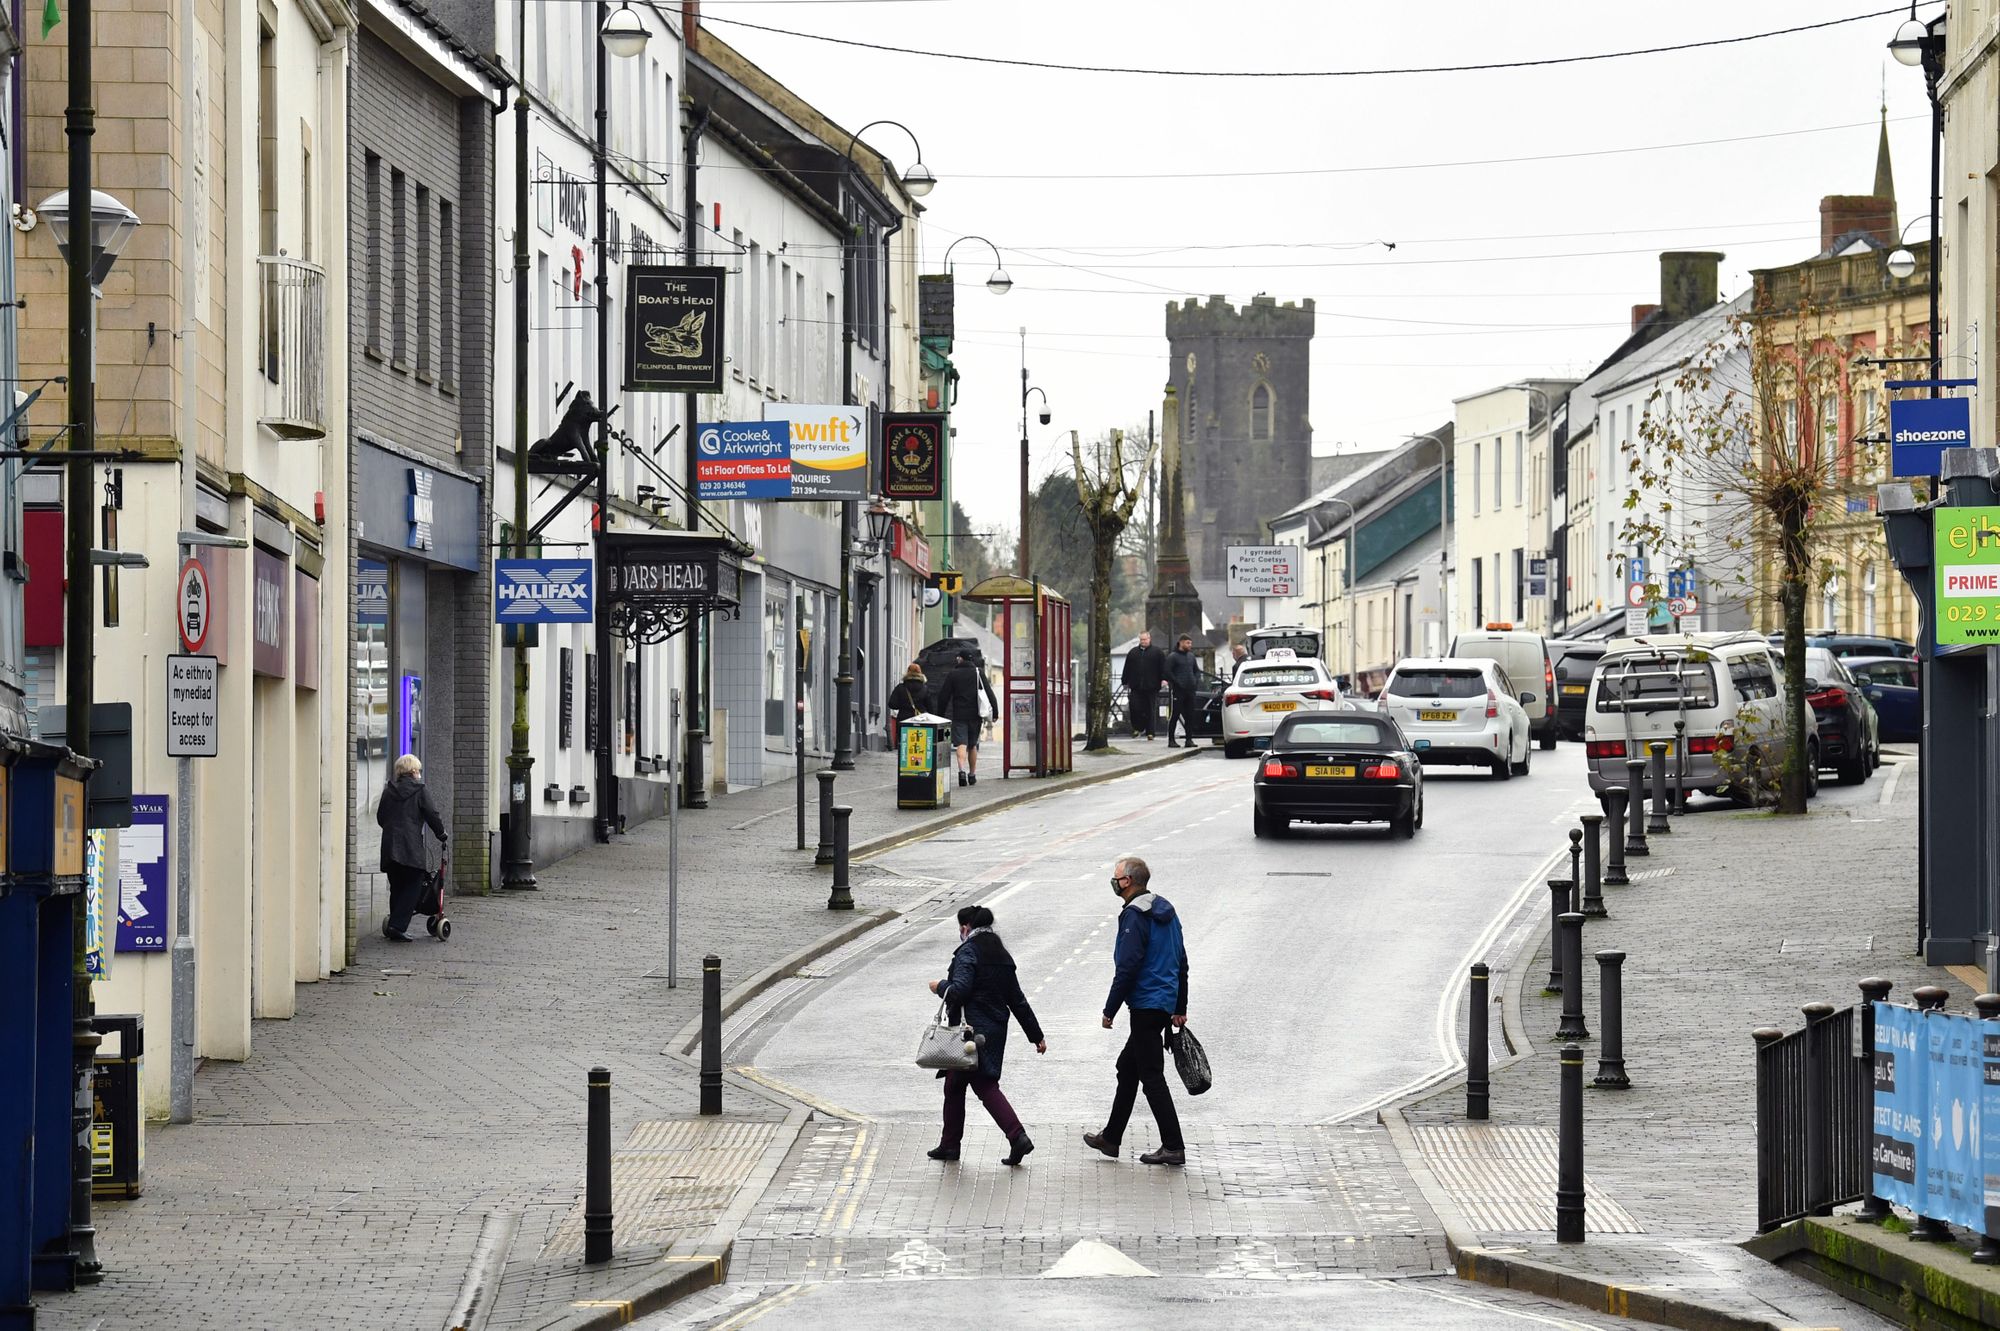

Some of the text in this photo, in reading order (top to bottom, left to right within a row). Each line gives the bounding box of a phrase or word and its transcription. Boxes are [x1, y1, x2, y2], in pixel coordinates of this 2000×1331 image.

[664, 282, 687, 292] THE
[638, 295, 714, 305] BOAR'S HEAD
[677, 363, 712, 371] BREWERY
[722, 429, 771, 442] Cooke&
[891, 432, 904, 451] ROSE
[912, 427, 934, 451] CROWN
[1895, 429, 1966, 443] shoezone
[723, 441, 783, 456] Arkwright
[819, 444, 850, 452] services
[700, 464, 791, 475] 1st Floor Offices To Let
[700, 482, 712, 490] 029
[722, 481, 746, 489] 346346
[791, 474, 831, 484] NQUIRIES
[804, 486, 817, 494] 394
[662, 565, 704, 589] HEAD
[1948, 575, 1998, 590] PRIME
[499, 583, 588, 599] HALIFAX
[1671, 604, 1684, 612] 20
[1947, 605, 1987, 622] 029
[173, 664, 212, 680] Ac eithrio
[173, 685, 212, 702] mynediad
[172, 711, 213, 728] Except for
[179, 734, 206, 746] access
